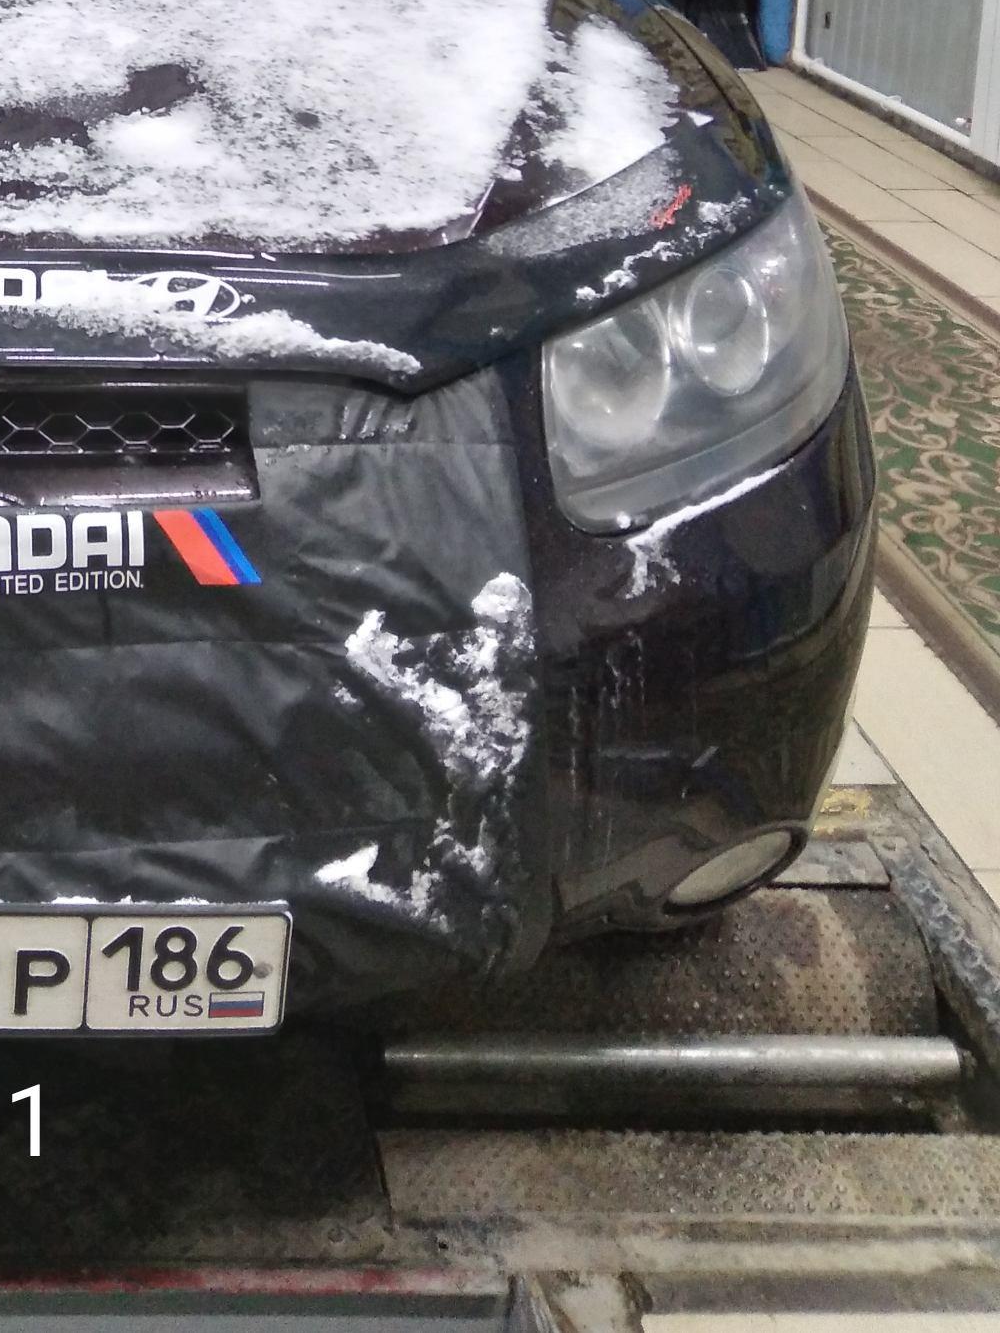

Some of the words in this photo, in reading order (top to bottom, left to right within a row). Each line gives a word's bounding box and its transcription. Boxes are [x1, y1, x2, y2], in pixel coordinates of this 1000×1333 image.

[55, 570, 145, 592] EDITION.
[101, 925, 254, 992] 186
[128, 994, 204, 1018] RUS
